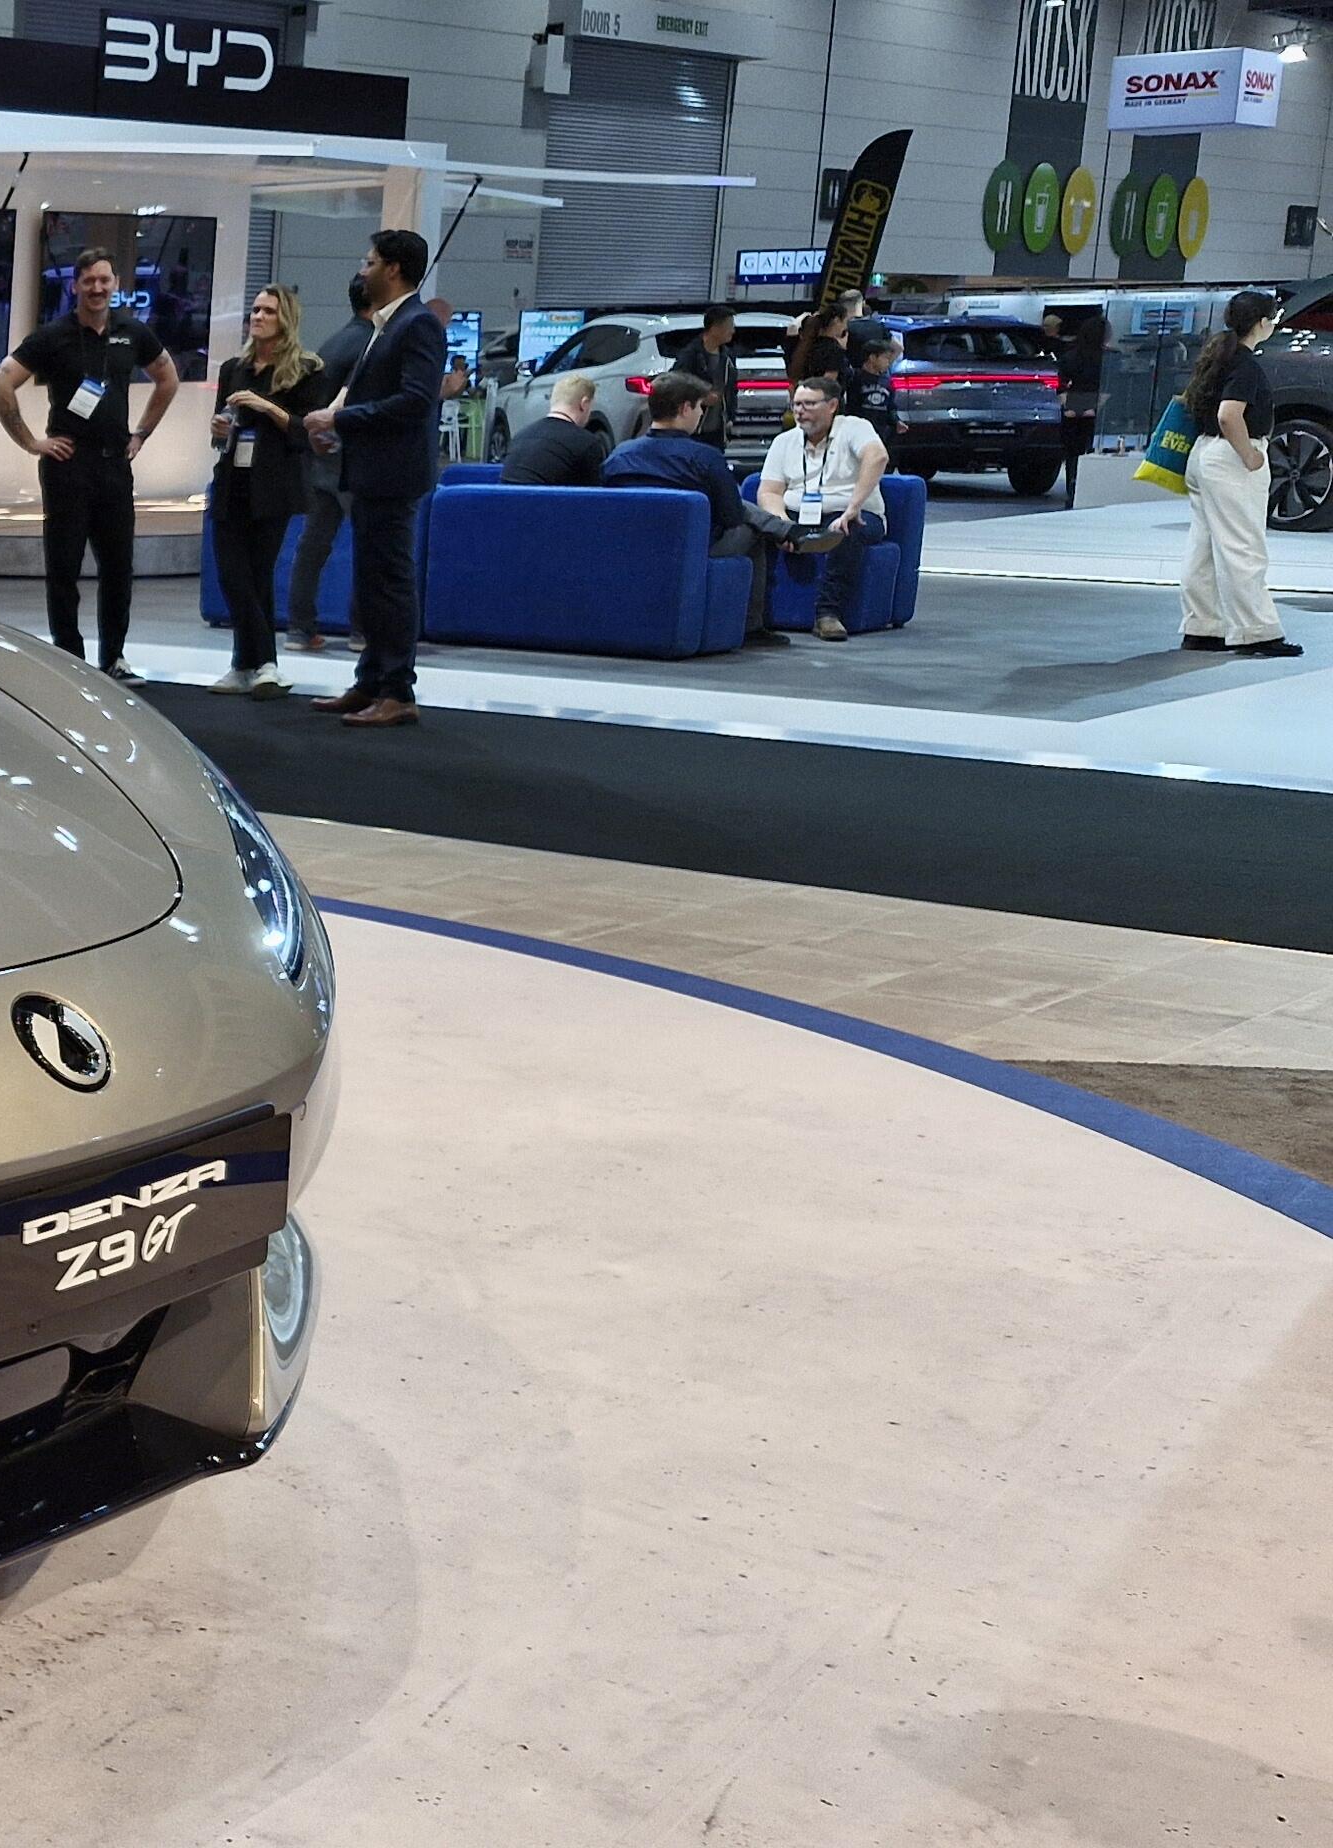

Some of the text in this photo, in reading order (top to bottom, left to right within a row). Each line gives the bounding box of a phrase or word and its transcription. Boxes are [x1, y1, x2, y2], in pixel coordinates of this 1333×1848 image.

[583, 9, 621, 36] DOOR 5
[656, 15, 709, 37] EMERGENCY EXIT
[104, 17, 274, 91] BYD
[1125, 70, 1219, 94] SONAX
[1245, 70, 1275, 91] SONAX
[1154, 98, 1187, 106] GERMANY
[821, 180, 891, 312] CHIVAL
[743, 255, 826, 270] GARA
[109, 290, 150, 308] BYD
[22, 1159, 227, 1246] DENZA
